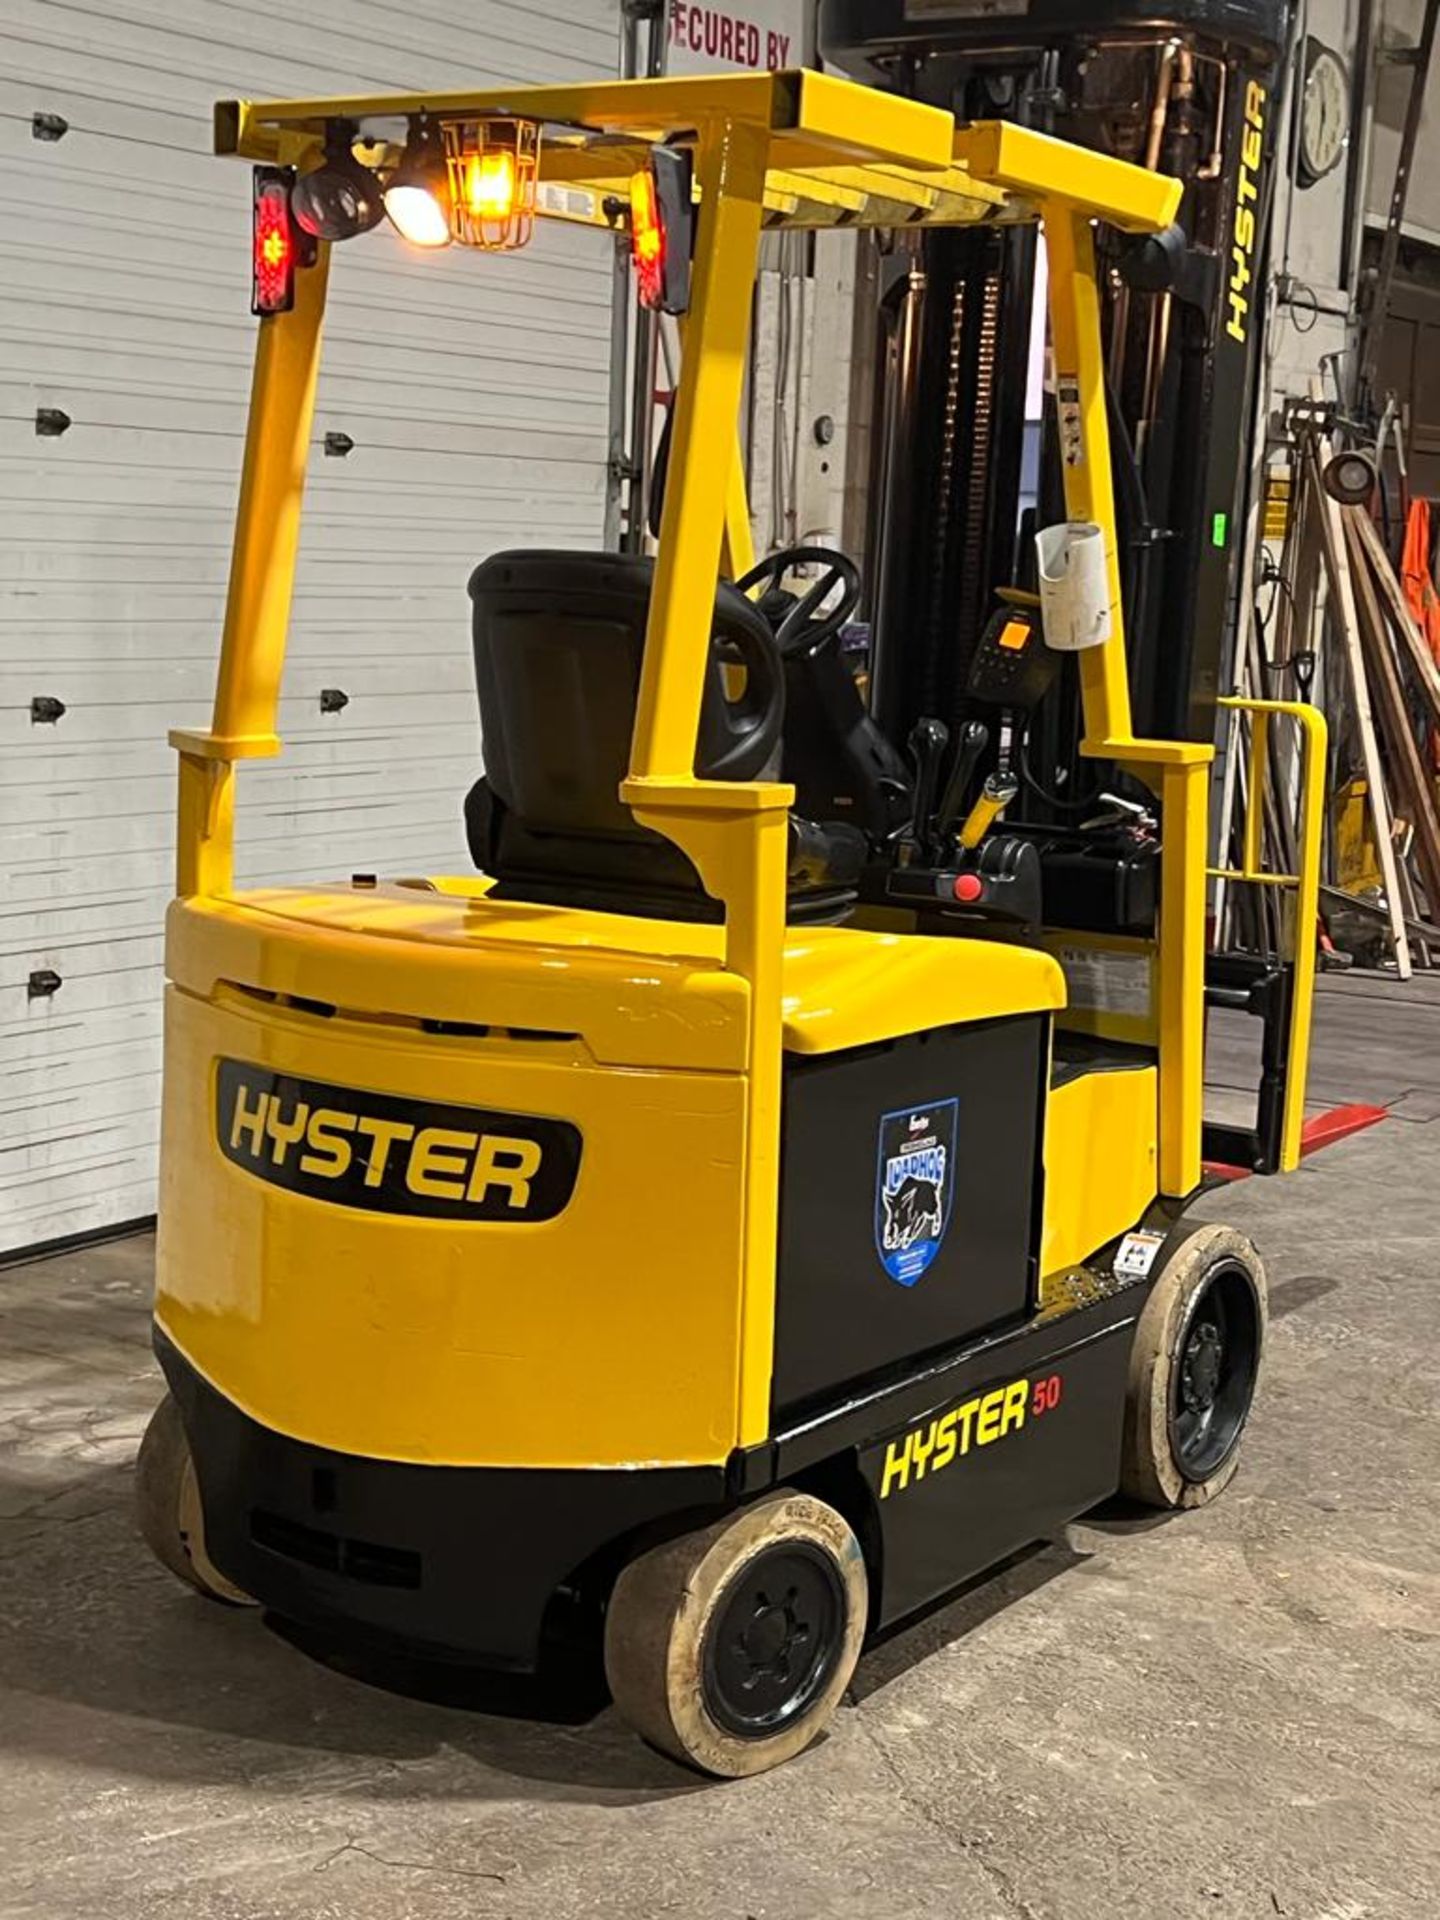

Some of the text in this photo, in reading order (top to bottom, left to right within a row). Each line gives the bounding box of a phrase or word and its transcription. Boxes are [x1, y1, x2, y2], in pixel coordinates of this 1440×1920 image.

[669, 2, 790, 72] ECURED BY
[1226, 80, 1265, 343] HYSTER
[230, 1085, 542, 1208] HYSTER
[879, 1375, 1061, 1499] HYSTER 50
